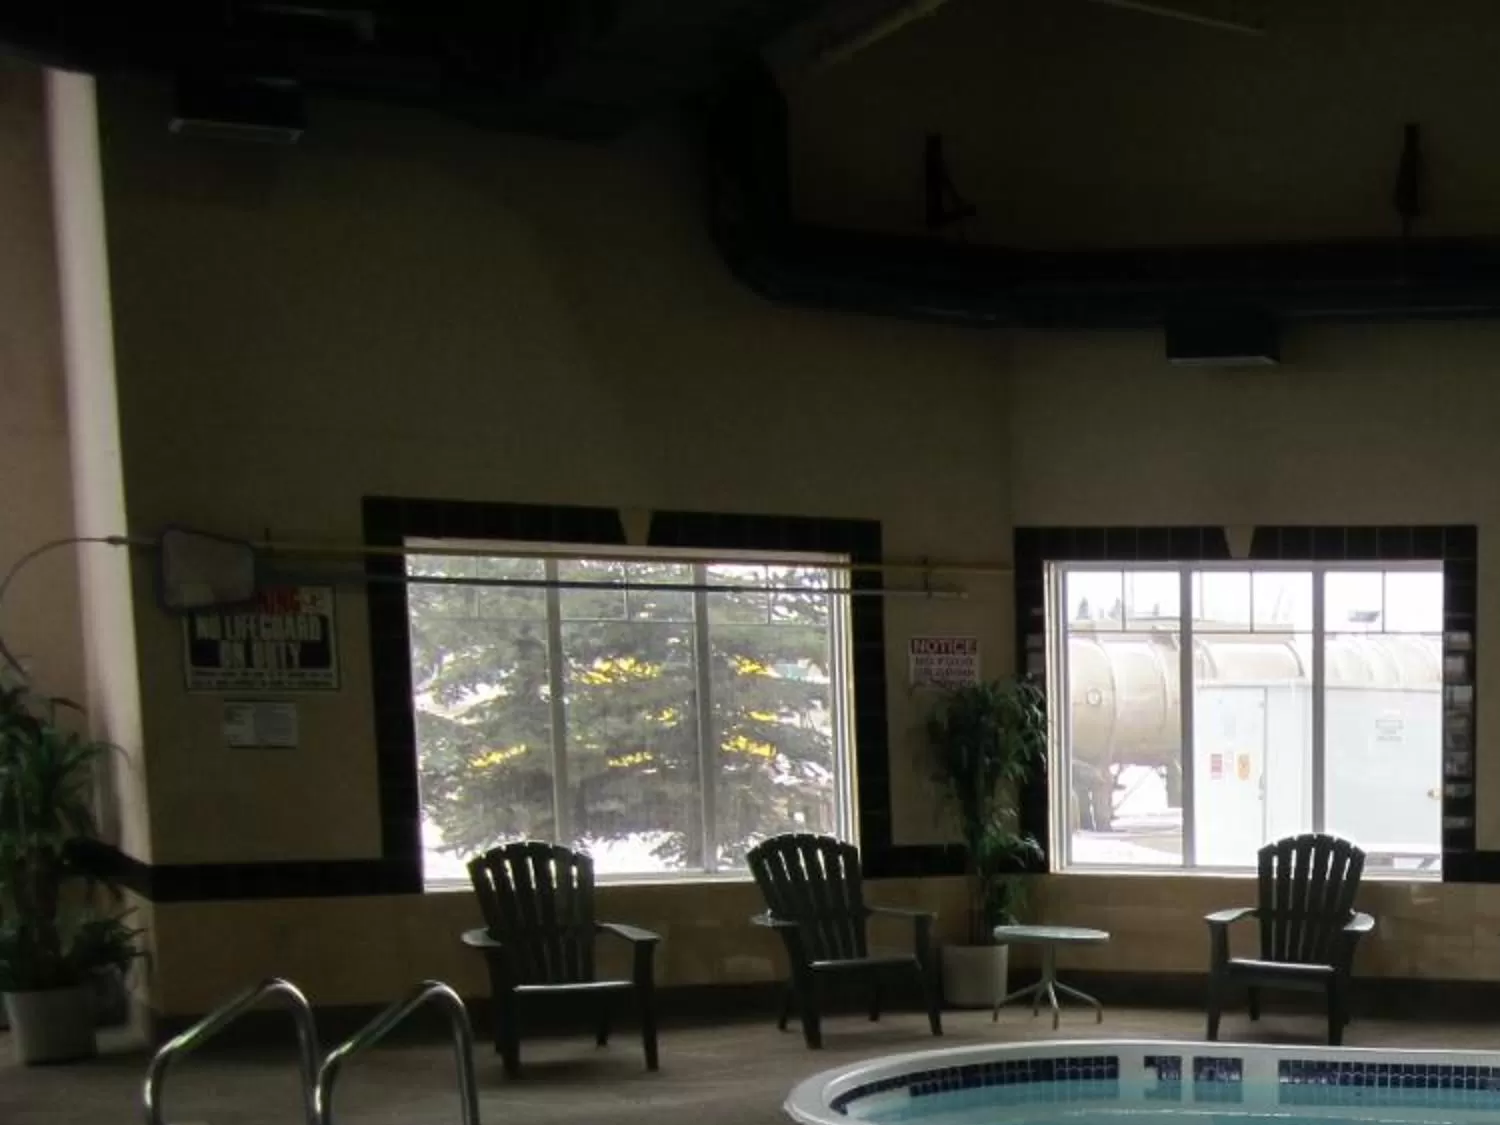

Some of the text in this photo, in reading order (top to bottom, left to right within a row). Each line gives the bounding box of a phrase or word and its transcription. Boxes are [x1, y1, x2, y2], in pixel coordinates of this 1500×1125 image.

[195, 614, 321, 641] NO LIFEGUARD
[220, 640, 302, 668] ON DUTY
[914, 639, 975, 654] NOTICE
